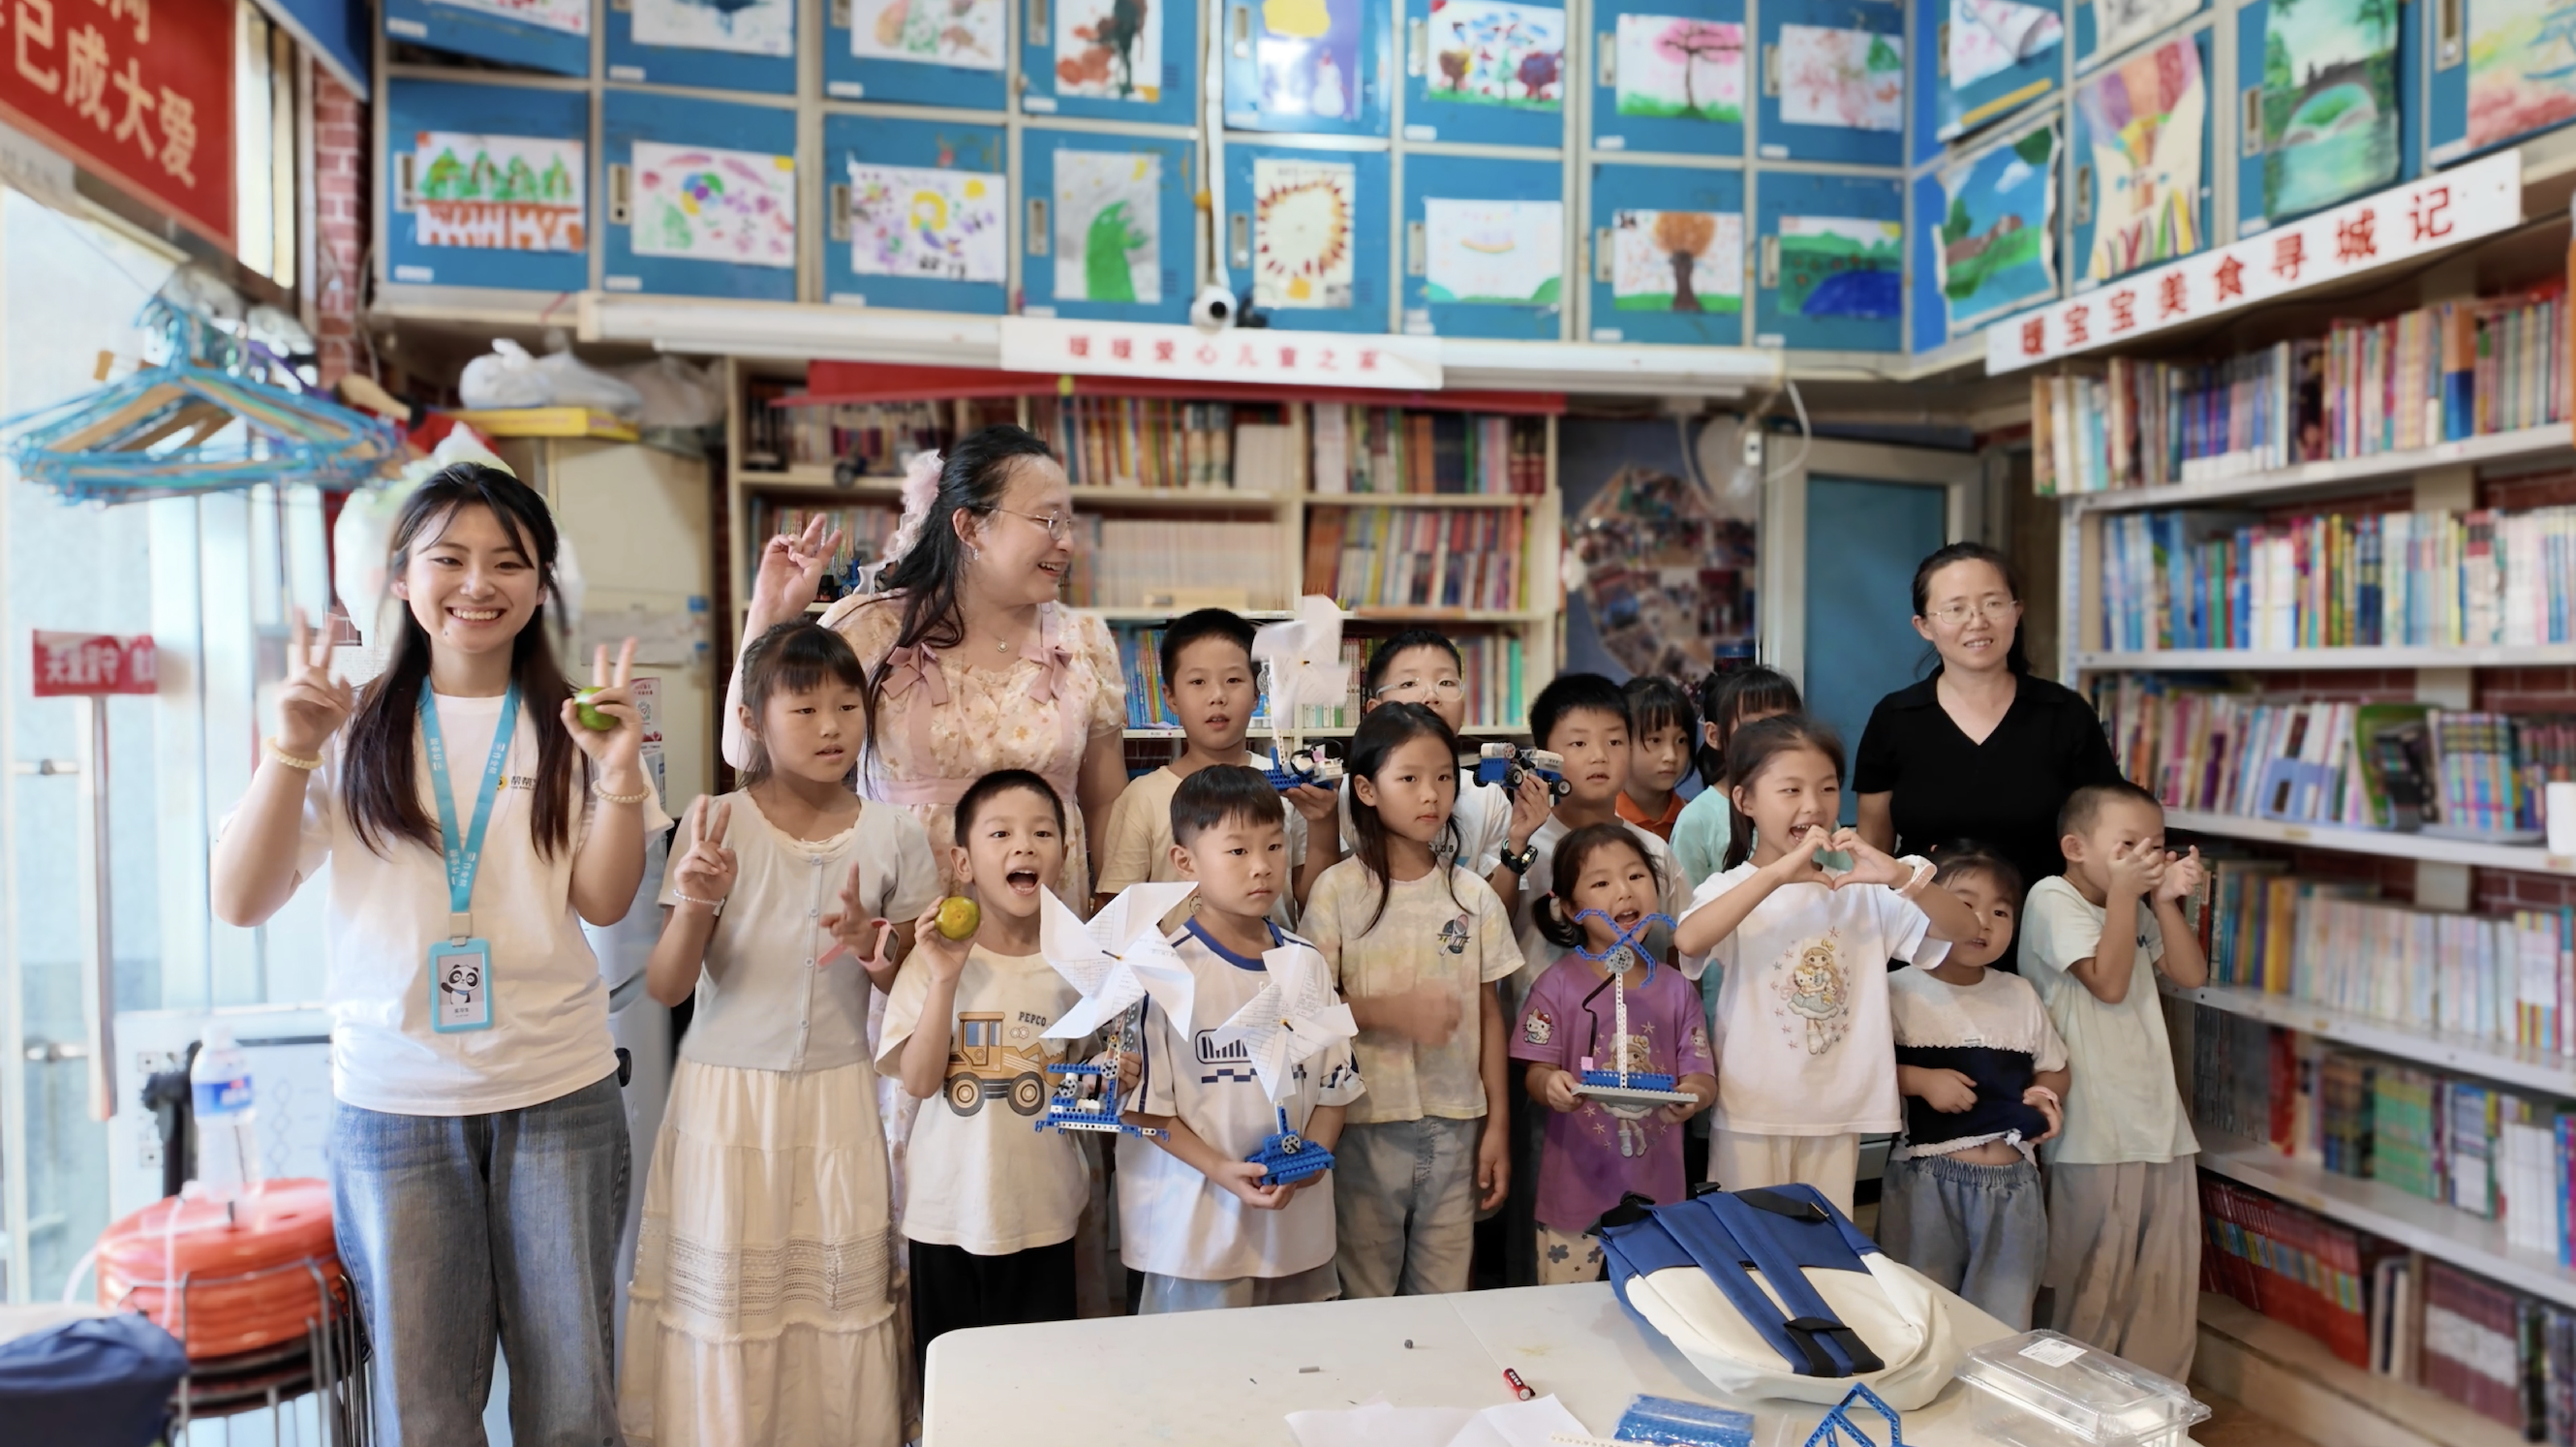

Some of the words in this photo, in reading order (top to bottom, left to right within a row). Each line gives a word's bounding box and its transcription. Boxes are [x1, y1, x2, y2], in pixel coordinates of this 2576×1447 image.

[0, 0, 197, 189] 已成大爱
[2020, 186, 2454, 357] 暖宝宝美食寻城记
[1069, 335, 1381, 372] 暖暖爱心儿童之家
[1018, 1010, 1047, 1028] PEPCO
